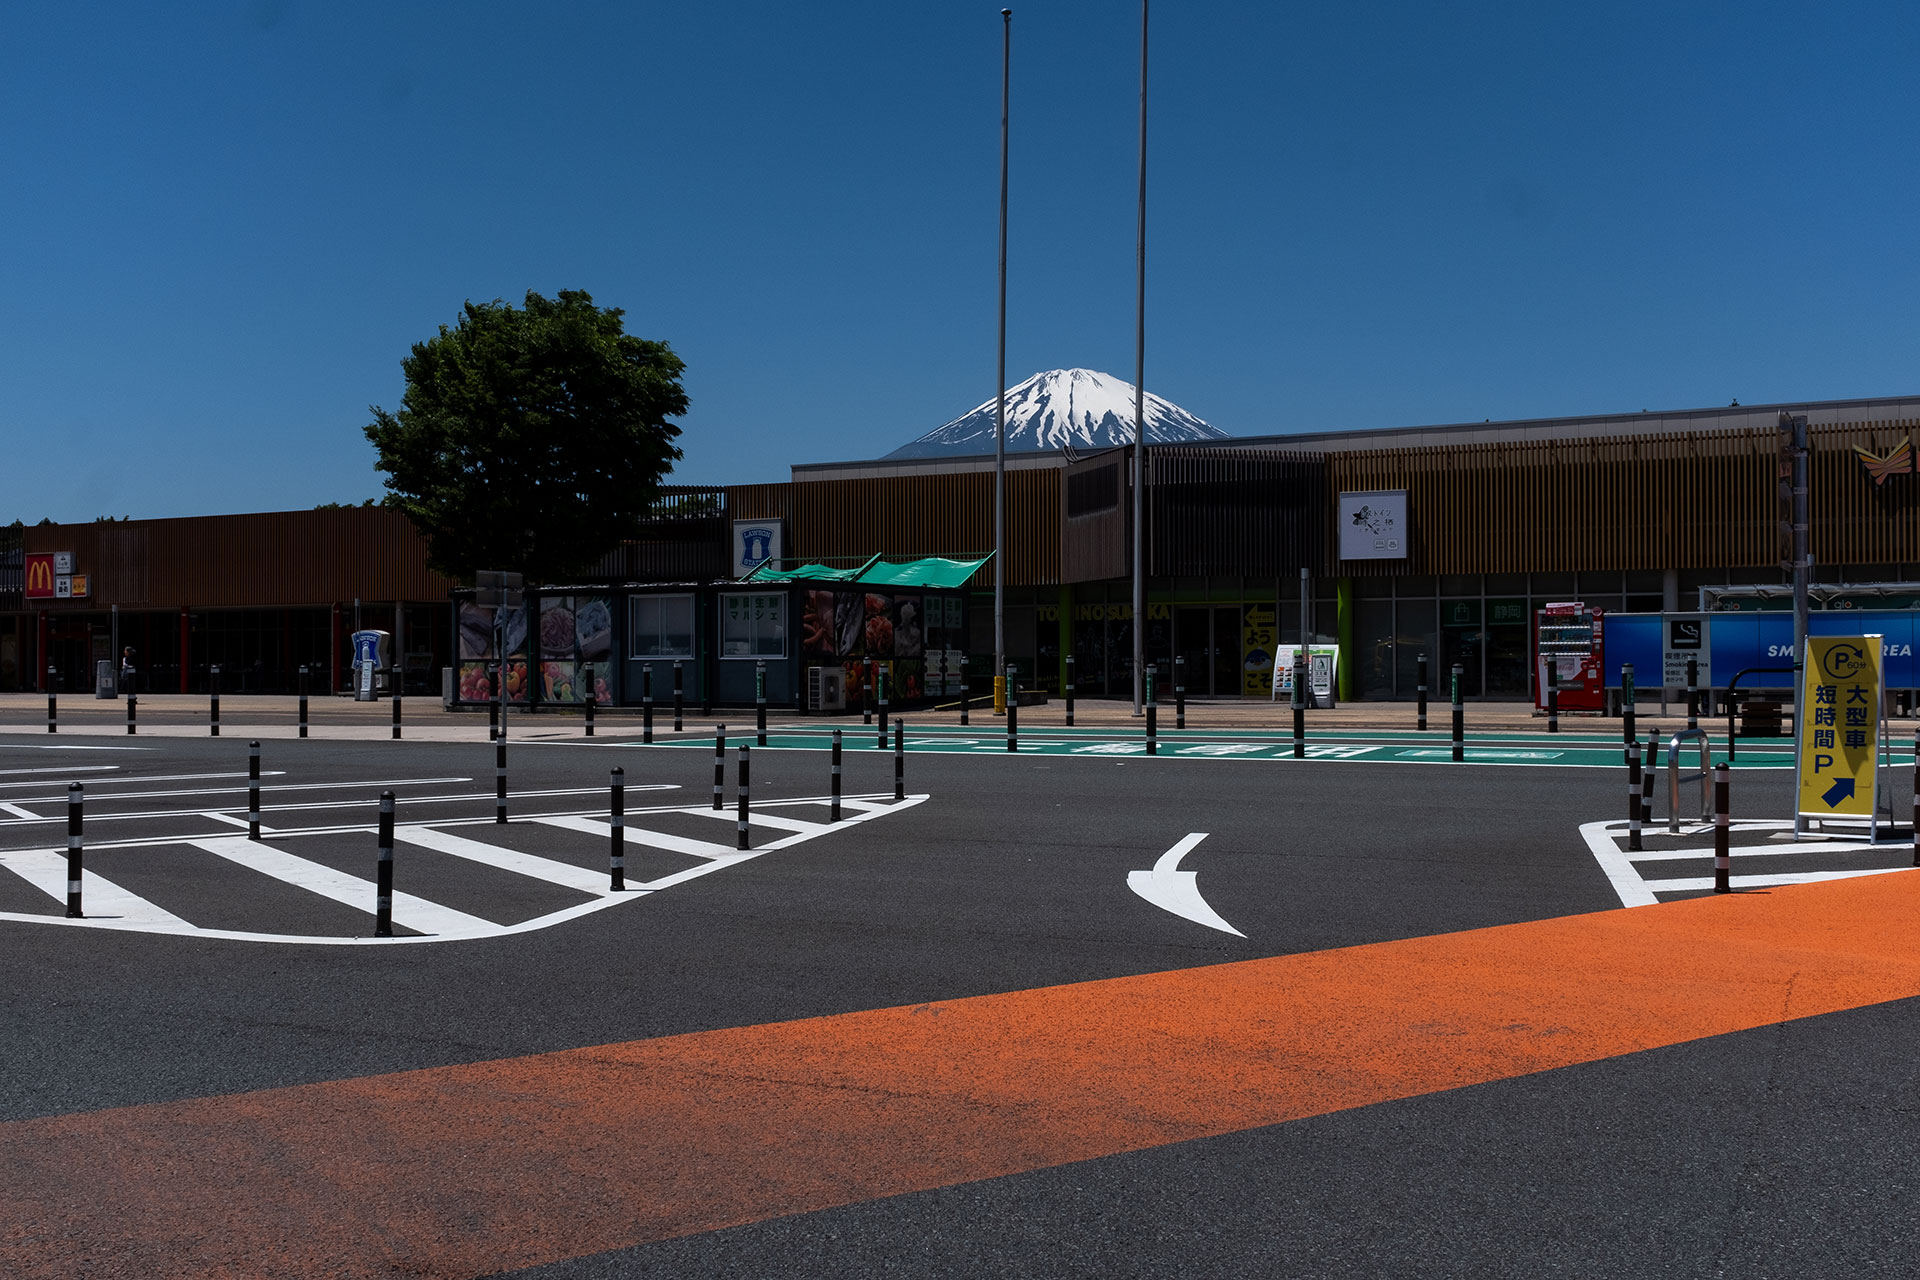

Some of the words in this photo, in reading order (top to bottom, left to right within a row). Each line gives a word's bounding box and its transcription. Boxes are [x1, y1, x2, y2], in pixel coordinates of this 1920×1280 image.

[1833, 600, 1853, 610] glo
[1247, 629, 1271, 645] よう
[1835, 652, 1850, 670] P
[1847, 661, 1866, 669] 60分
[1246, 673, 1272, 689] こそ
[1844, 684, 1869, 749] 大型車
[1814, 685, 1837, 774] 短時間P
